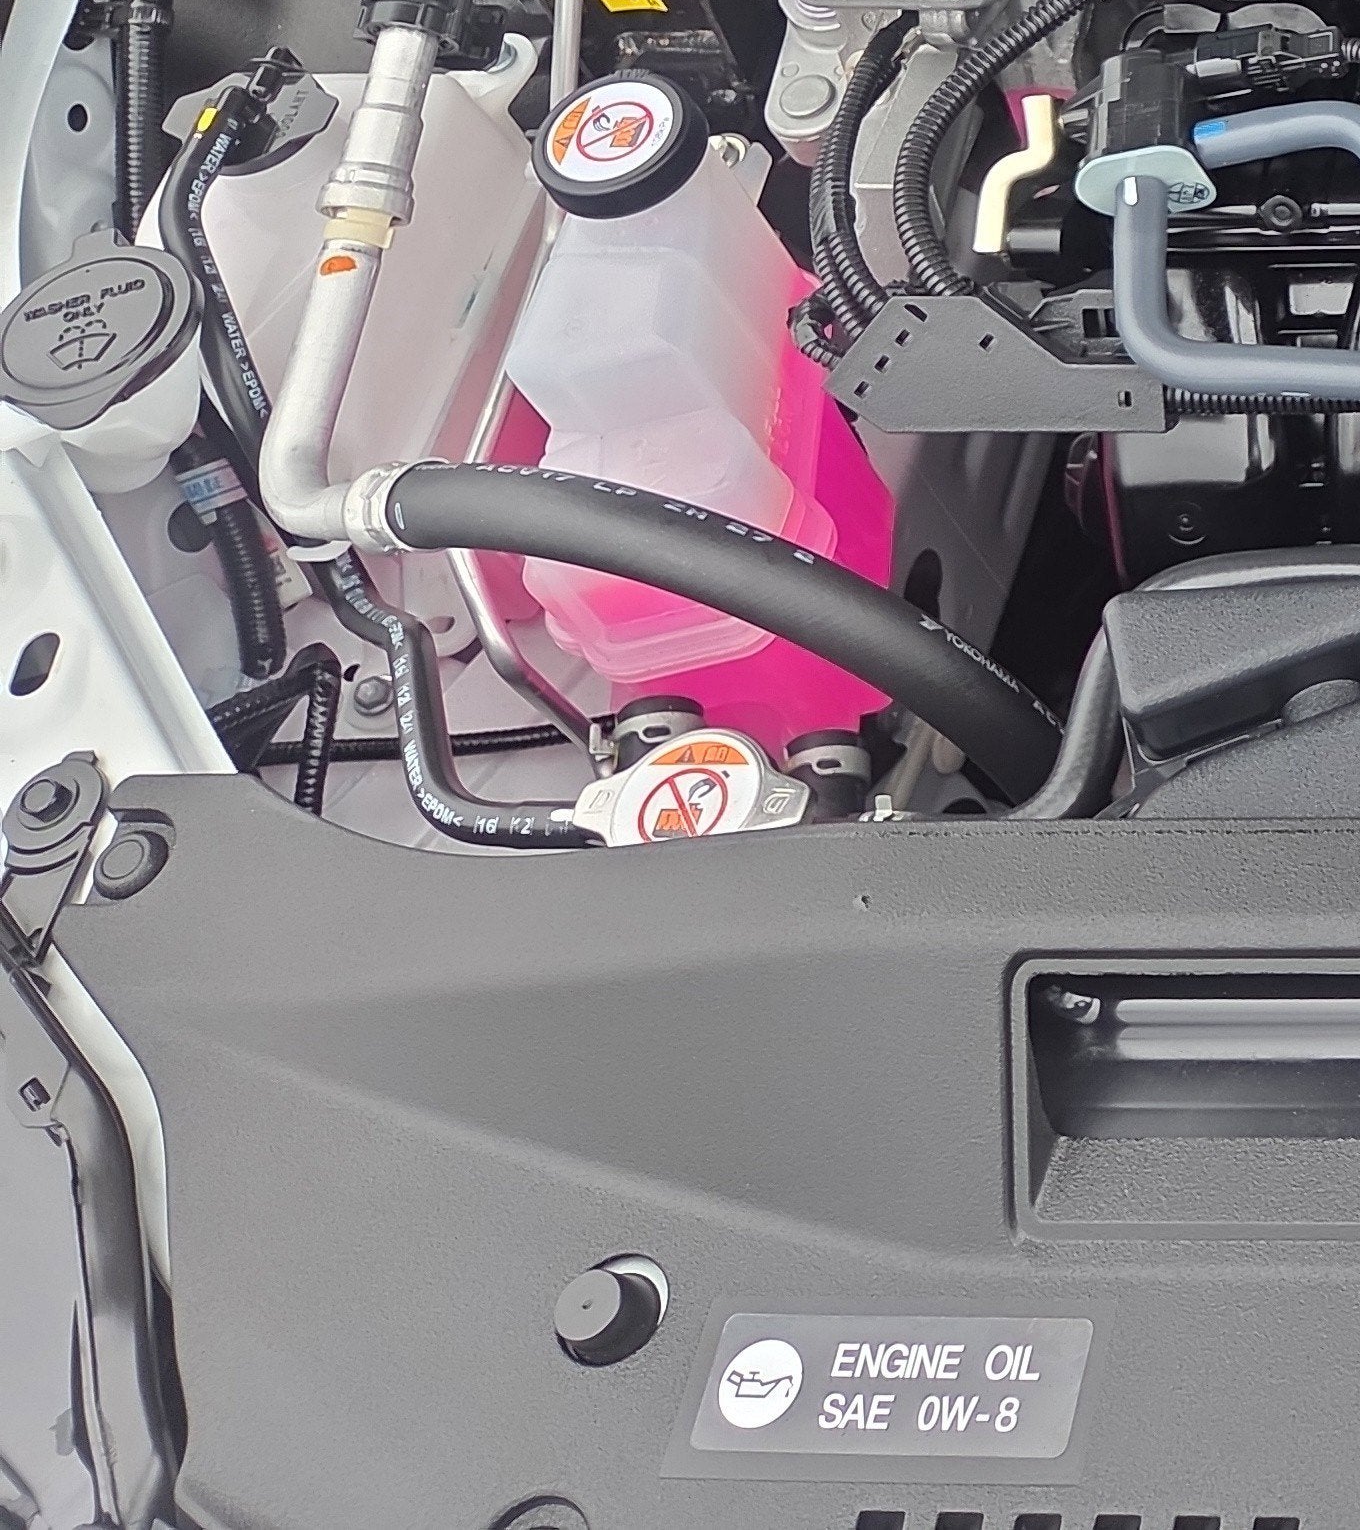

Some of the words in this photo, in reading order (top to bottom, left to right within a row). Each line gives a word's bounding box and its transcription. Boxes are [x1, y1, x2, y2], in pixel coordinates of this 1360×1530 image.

[202, 132, 231, 176] WATER
[24, 294, 91, 322] WASHER
[100, 278, 146, 300] FLUID
[62, 302, 105, 323] ONLY
[221, 311, 246, 360] WATER
[945, 629, 1020, 693] YOKOHAMA
[402, 738, 424, 791] WATER
[830, 1343, 966, 1380] ENGINE
[985, 1343, 1041, 1382] OIL
[818, 1392, 895, 1432] SAE
[917, 1394, 1020, 1434] 0W-8
